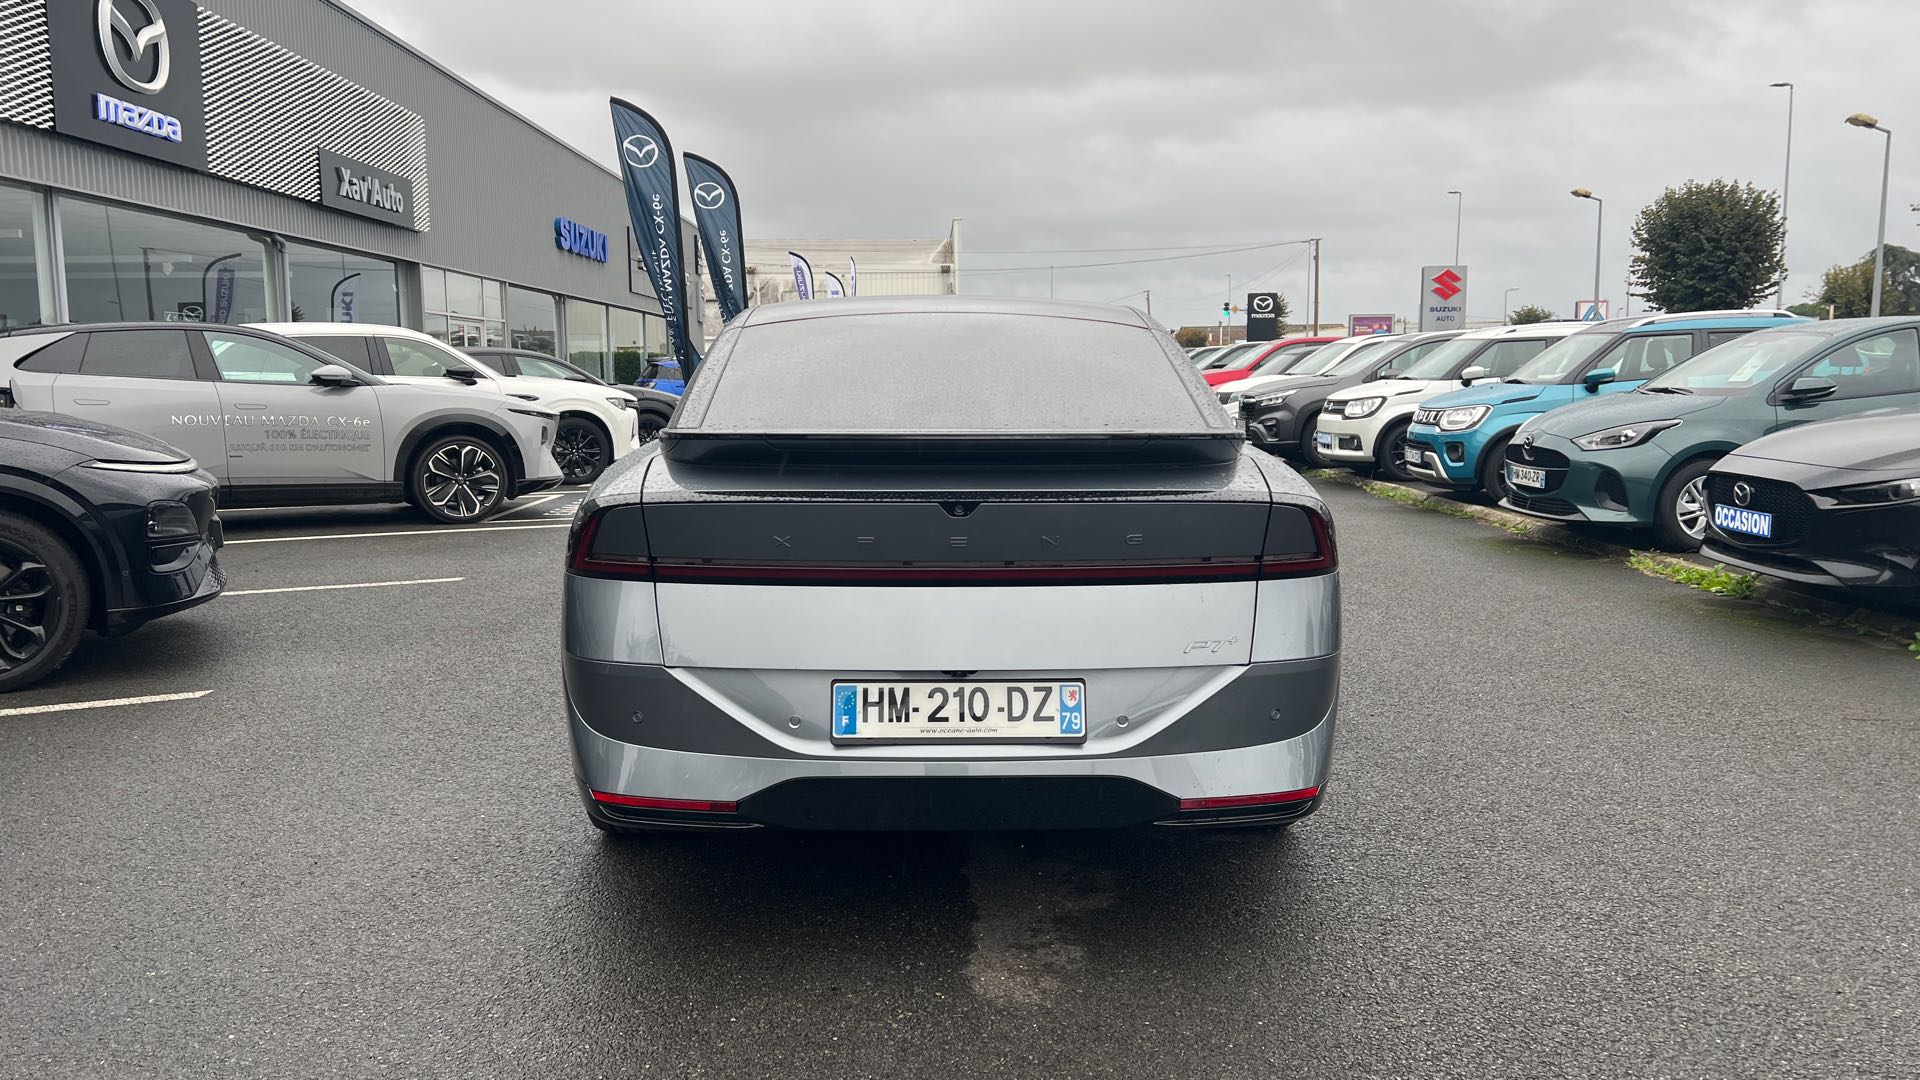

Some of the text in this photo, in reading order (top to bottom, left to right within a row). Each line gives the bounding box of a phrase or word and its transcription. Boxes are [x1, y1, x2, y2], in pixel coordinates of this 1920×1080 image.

[338, 166, 404, 213] Xav'Auto
[554, 216, 608, 264] SUZUKI
[171, 415, 371, 428] NOUVEAU MAZDA CX-6e
[264, 427, 371, 442] 100% ÉLECTRIQUE
[1715, 506, 1770, 536] OCCASION
[1183, 634, 1239, 654] P7+
[861, 686, 1056, 723] HM-210-DZ
[842, 716, 849, 727] F
[919, 727, 999, 735] www.oceane-auto.com
[1061, 712, 1081, 731] 79
